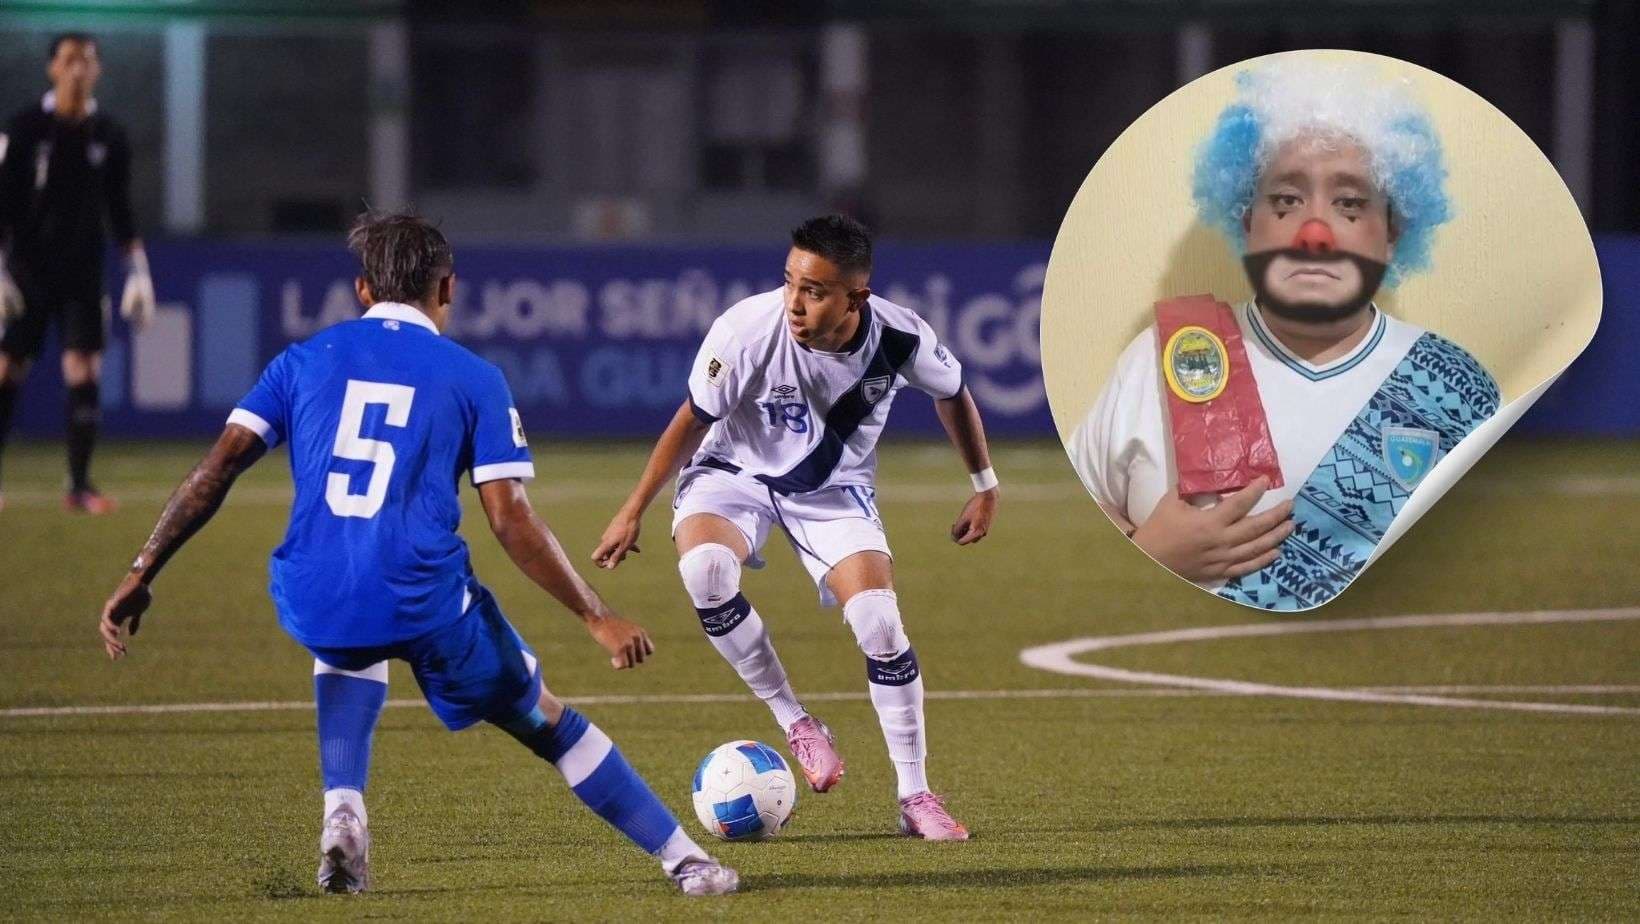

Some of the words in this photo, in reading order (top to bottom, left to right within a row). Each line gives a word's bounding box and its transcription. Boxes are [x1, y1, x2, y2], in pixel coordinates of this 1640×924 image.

[762, 402, 808, 434] 18
[325, 379, 416, 519] 5
[705, 614, 741, 632] umbro
[877, 669, 916, 681] umbro
